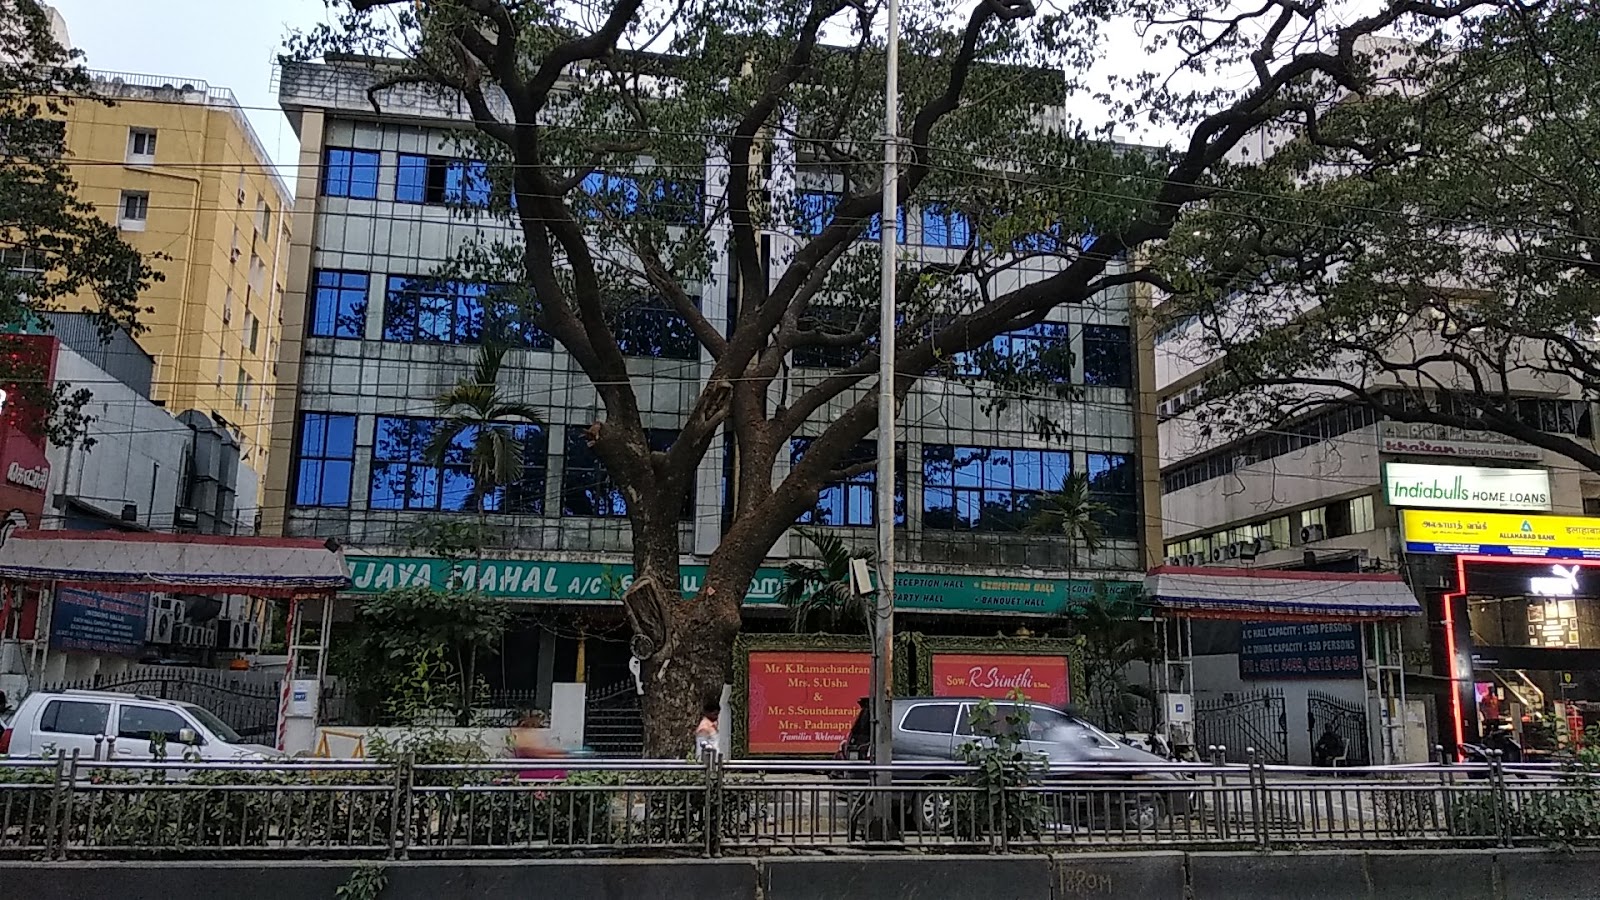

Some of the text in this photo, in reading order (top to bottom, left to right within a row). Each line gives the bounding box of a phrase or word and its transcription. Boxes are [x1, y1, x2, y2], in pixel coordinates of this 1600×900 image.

[1458, 447, 1489, 456] Electricals
[1491, 449, 1512, 457] Limited
[1514, 450, 1538, 459] Chennai
[1394, 475, 1546, 503] Indiabulls HOME LOANS
[1499, 532, 1536, 540] ALLAHABAD
[446, 564, 558, 592] MAHAL
[894, 578, 940, 587] RECEPTION
[943, 580, 964, 588] HALL
[981, 581, 1031, 591] EXHIBITION
[1033, 583, 1055, 592] HALL
[893, 593, 1045, 607] PARTY HALL BANQUET HALL
[1253, 628, 1268, 638] HALL
[1302, 625, 1319, 635] 1500
[1320, 623, 1353, 633] PERSONS
[1253, 644, 1273, 653] DINING
[1273, 642, 1303, 653] CAPACITY
[1308, 641, 1321, 651] 350
[1322, 640, 1355, 650] PERSONS
[765, 663, 870, 674] Mr. K.Ramachandran
[788, 678, 848, 688] Mrs. S.Usha
[946, 675, 968, 686] Sow.
[813, 692, 823, 701] &
[768, 706, 861, 717] Mr. S.Soundararaja
[778, 720, 852, 732] Mrs. Padmapri
[780, 732, 812, 742] Families
